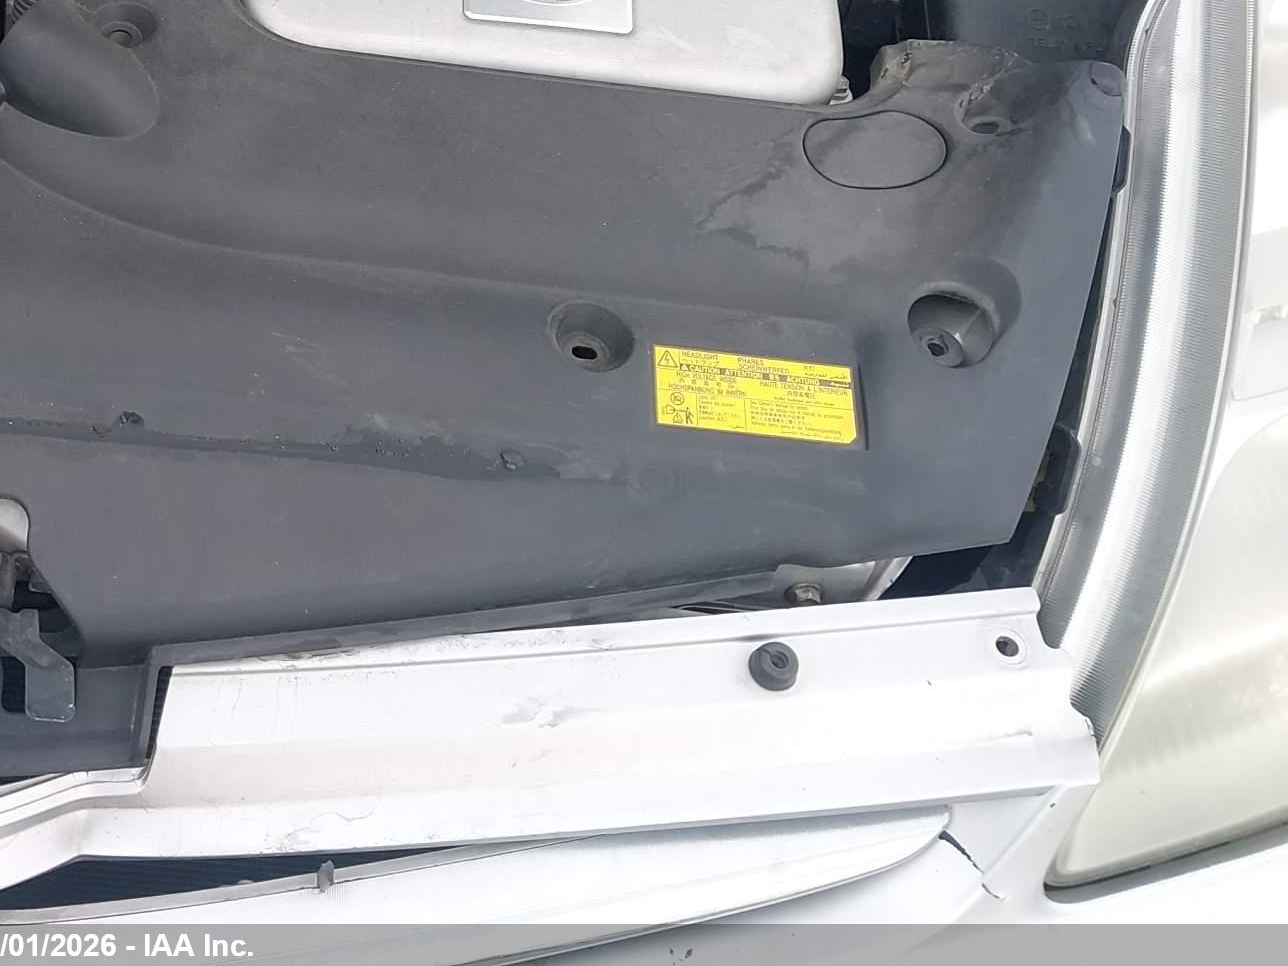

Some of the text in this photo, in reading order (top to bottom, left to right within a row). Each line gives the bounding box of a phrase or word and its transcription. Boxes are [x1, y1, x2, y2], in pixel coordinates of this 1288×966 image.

[681, 351, 719, 360] HEADLIGHT
[737, 357, 765, 366] PHARES
[738, 363, 790, 375] SCHEINWERFER
[690, 364, 721, 375] CAUTION
[725, 369, 763, 379] ATTENTION
[786, 375, 820, 386] ACHTUNG
